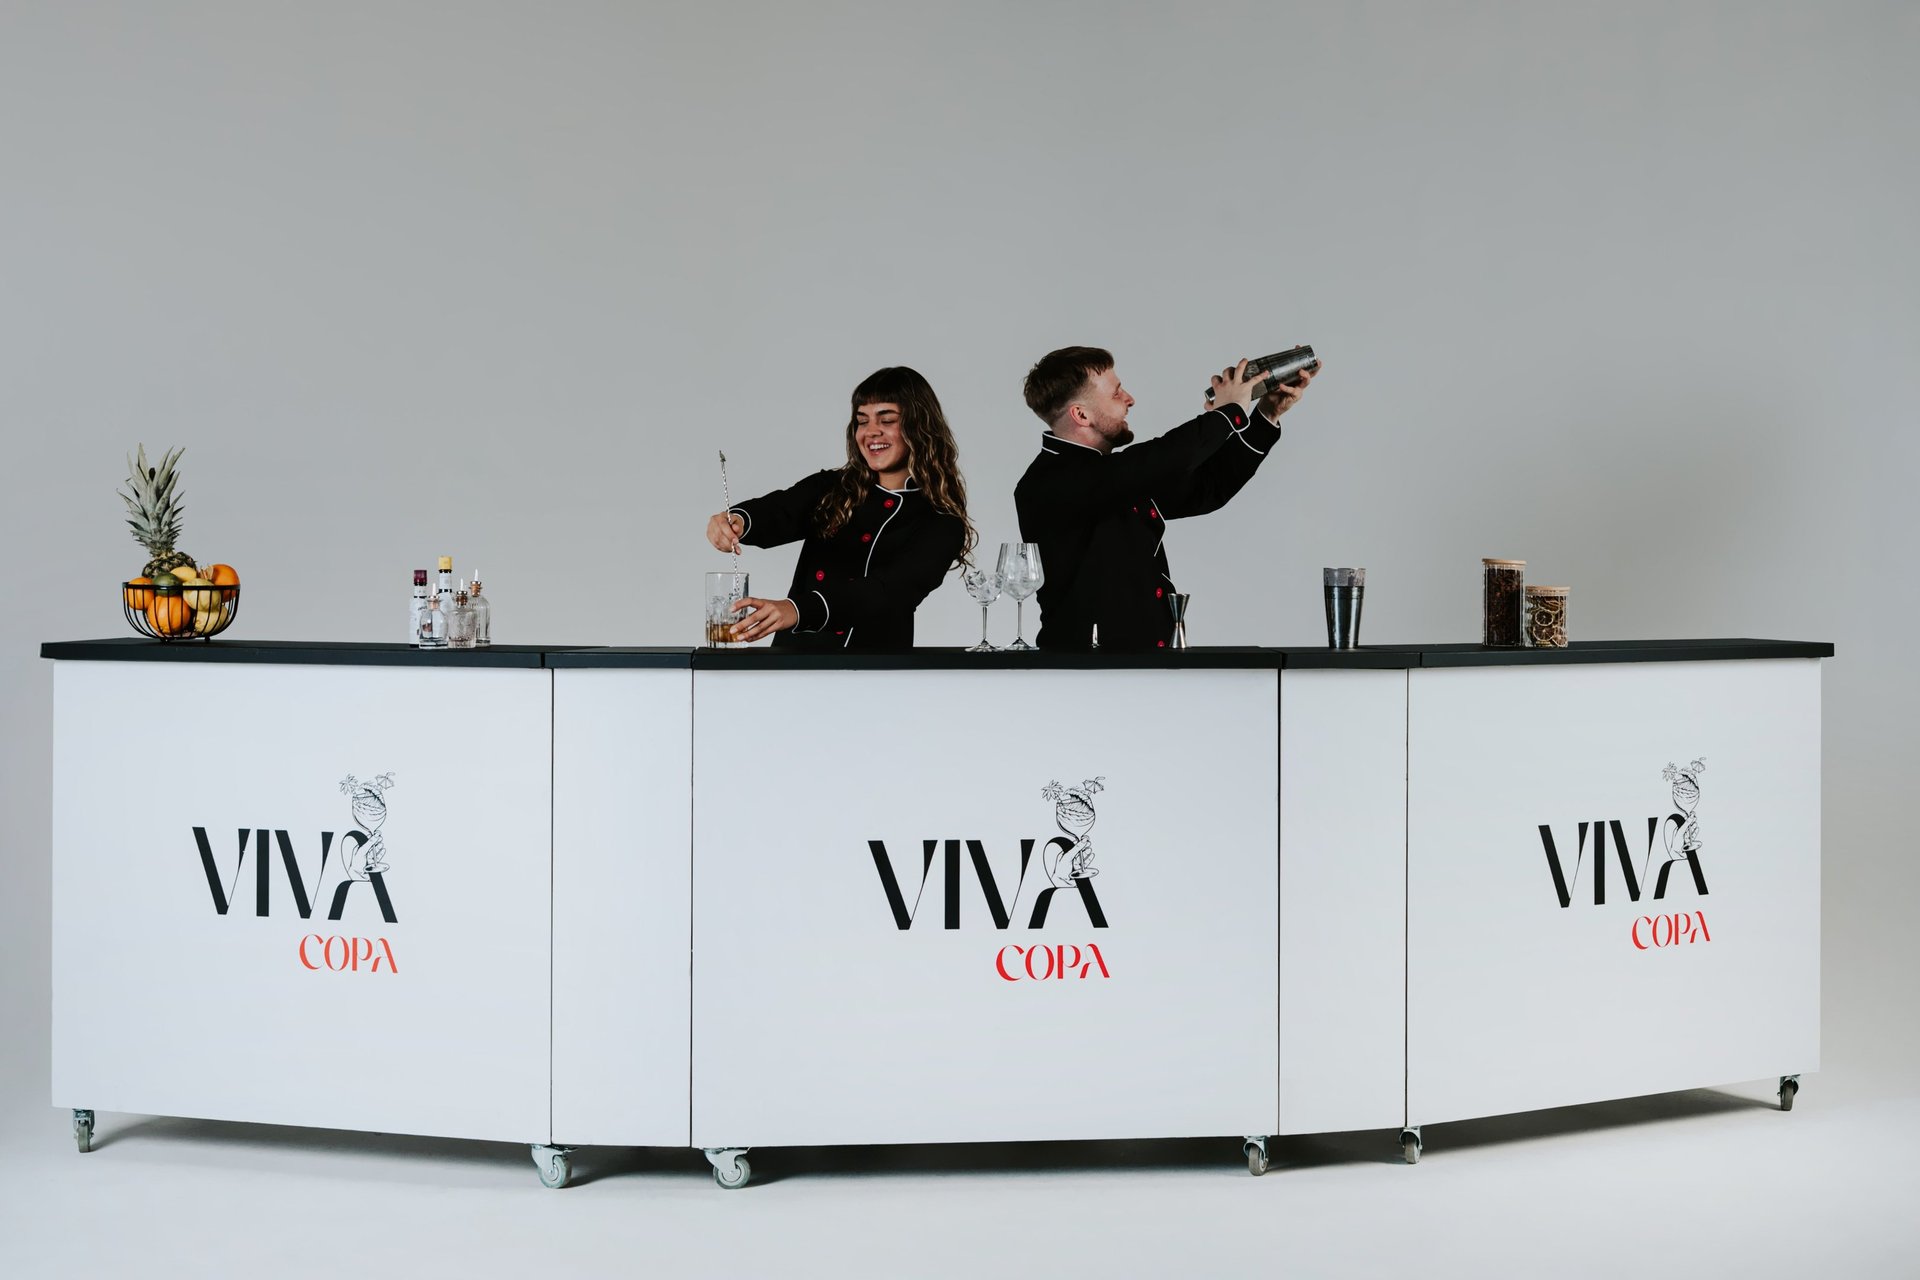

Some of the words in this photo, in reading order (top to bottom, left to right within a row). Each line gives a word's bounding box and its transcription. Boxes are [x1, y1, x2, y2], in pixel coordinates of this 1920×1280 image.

[192, 826, 398, 924] VIVA
[867, 836, 1109, 930] VIVA
[1538, 813, 1709, 908] VIVA
[299, 933, 398, 974] COPA
[995, 943, 1110, 982] COPA
[1631, 910, 1711, 950] COPA
